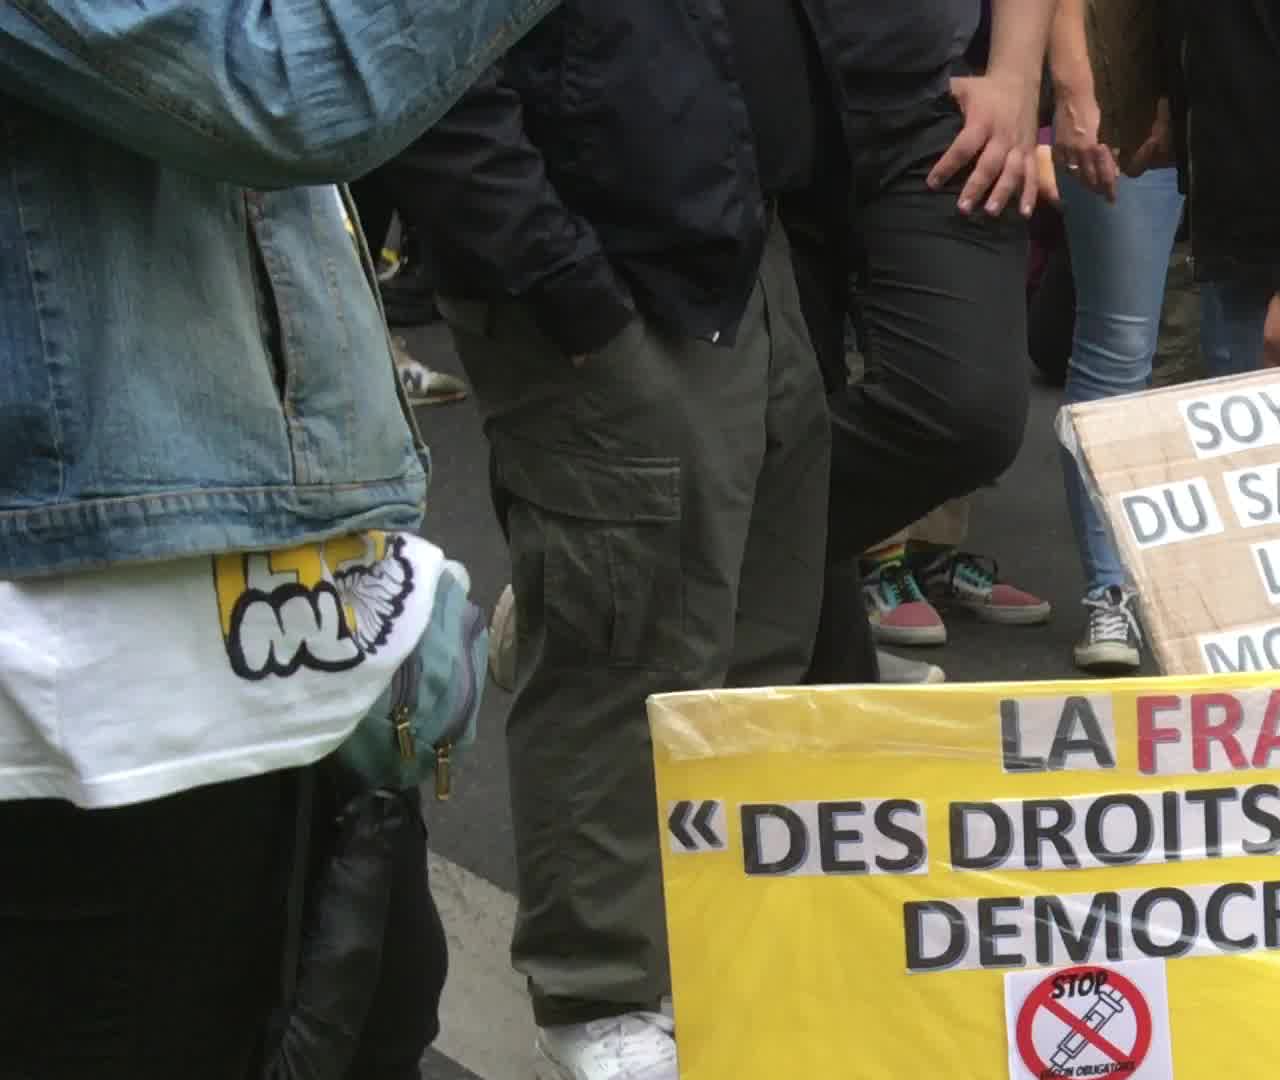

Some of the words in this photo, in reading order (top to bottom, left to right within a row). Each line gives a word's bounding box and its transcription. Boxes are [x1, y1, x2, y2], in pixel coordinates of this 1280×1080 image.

[1122, 485, 1213, 543] DU
[1000, 696, 1116, 771] LA
[741, 800, 926, 875] DES
[1051, 969, 1109, 999] STOP
